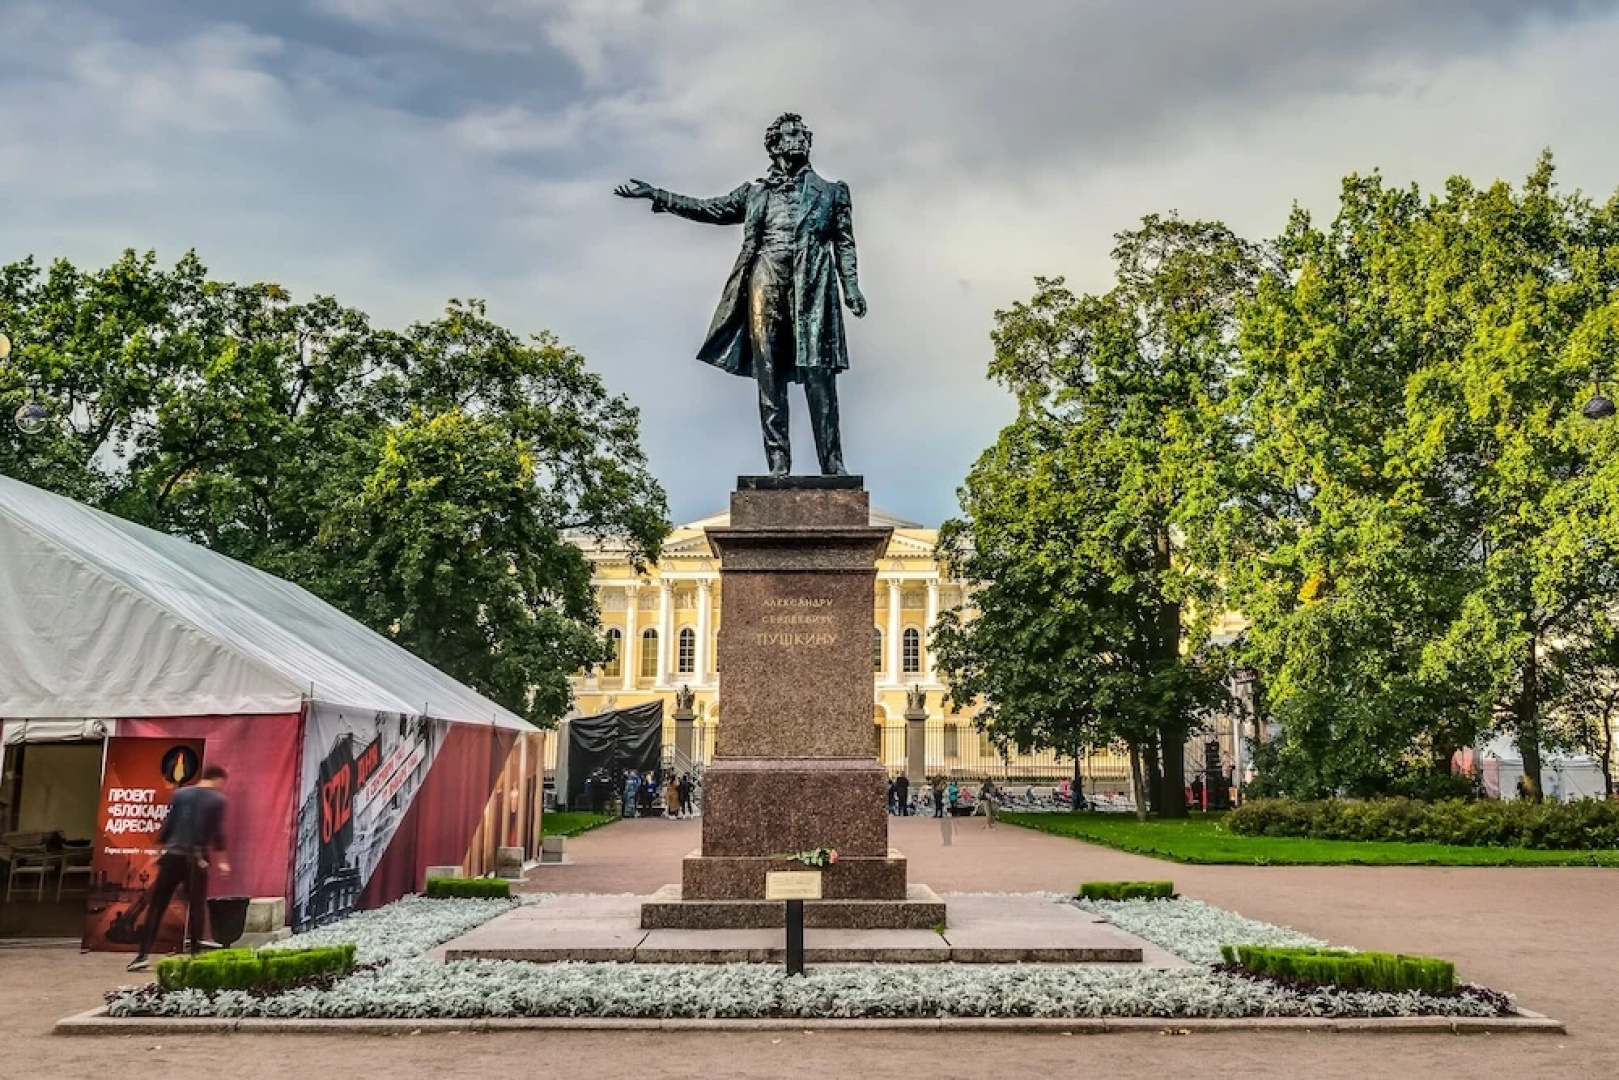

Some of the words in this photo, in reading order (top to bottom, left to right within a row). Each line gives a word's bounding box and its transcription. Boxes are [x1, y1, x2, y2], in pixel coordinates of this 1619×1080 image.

[761, 598, 833, 608] АЛЕКСАНДРУ
[756, 633, 837, 645] ПУШКИНУ
[108, 788, 156, 803] ПРОЕКТ
[323, 763, 351, 843] 872
[107, 804, 173, 820] «БЛОКАДН
[104, 818, 163, 834] АДРЕСА»
